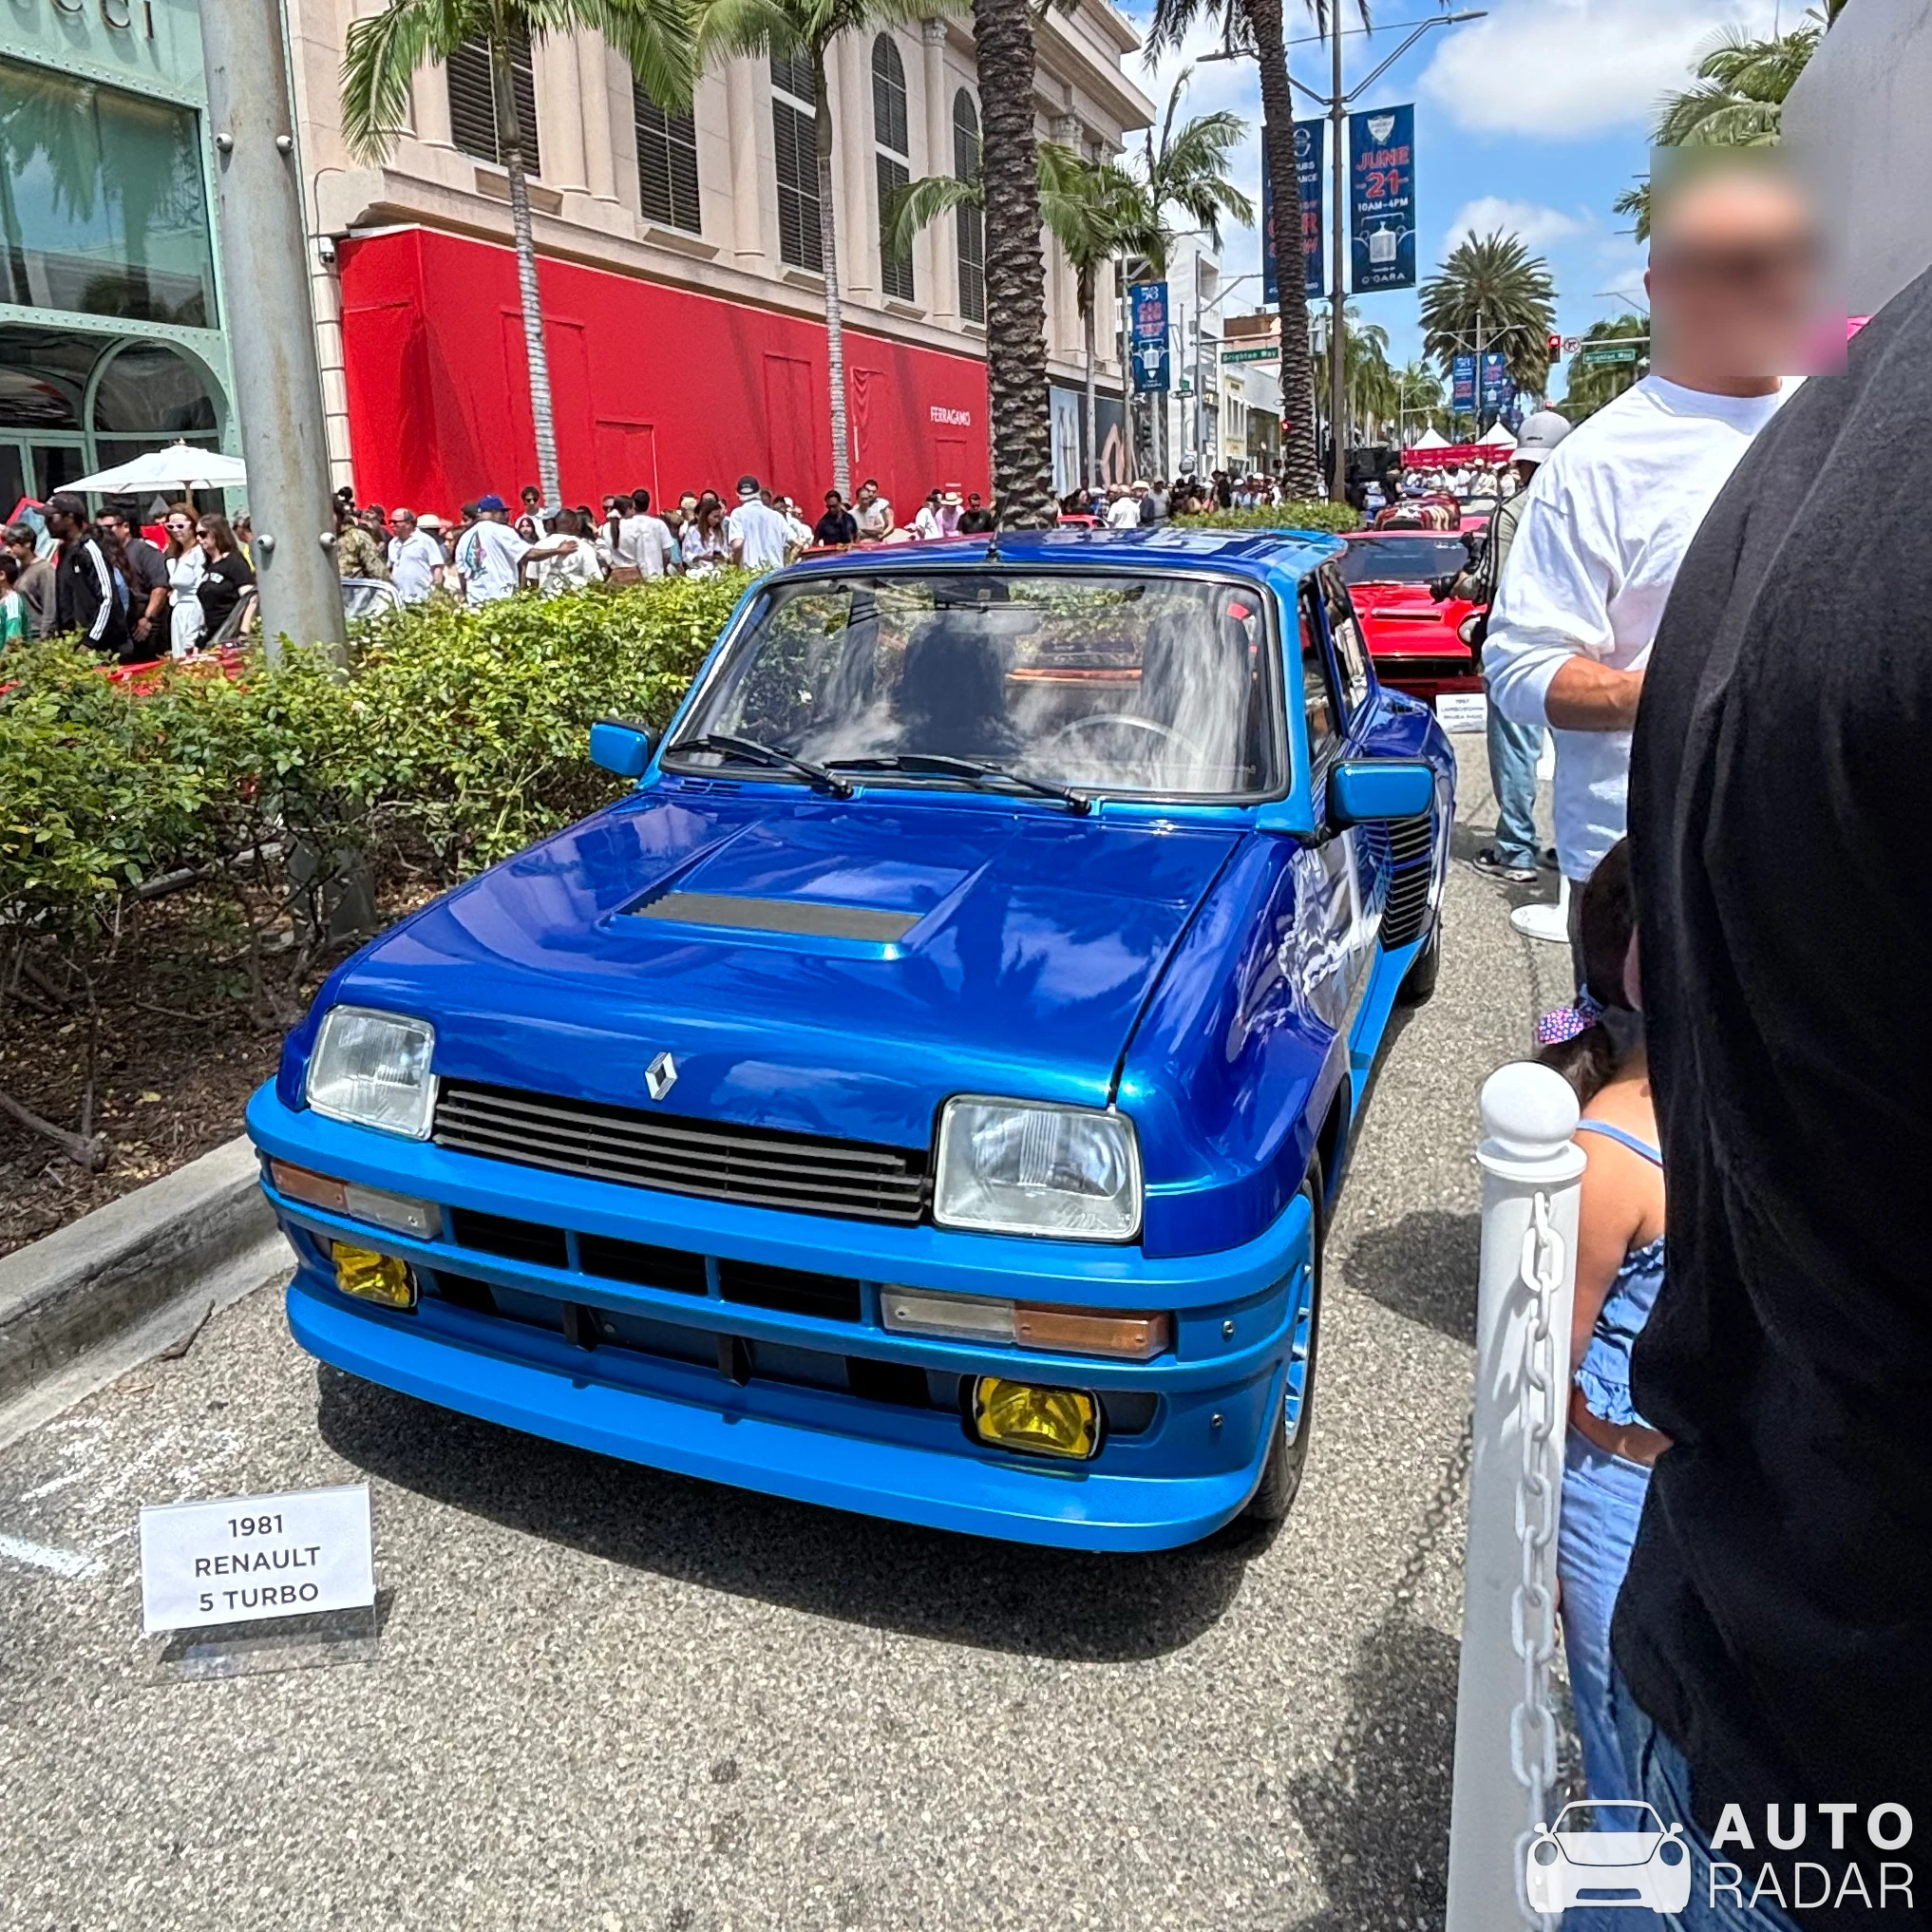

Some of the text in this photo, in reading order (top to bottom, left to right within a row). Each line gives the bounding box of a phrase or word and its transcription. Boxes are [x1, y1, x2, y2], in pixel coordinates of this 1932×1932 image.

[1356, 146, 1410, 171] JUNE
[930, 407, 970, 426] FERRAGAMO
[228, 1514, 283, 1538] 1981
[195, 1546, 321, 1577] RENAULT
[199, 1582, 319, 1612] 5 TURBO
